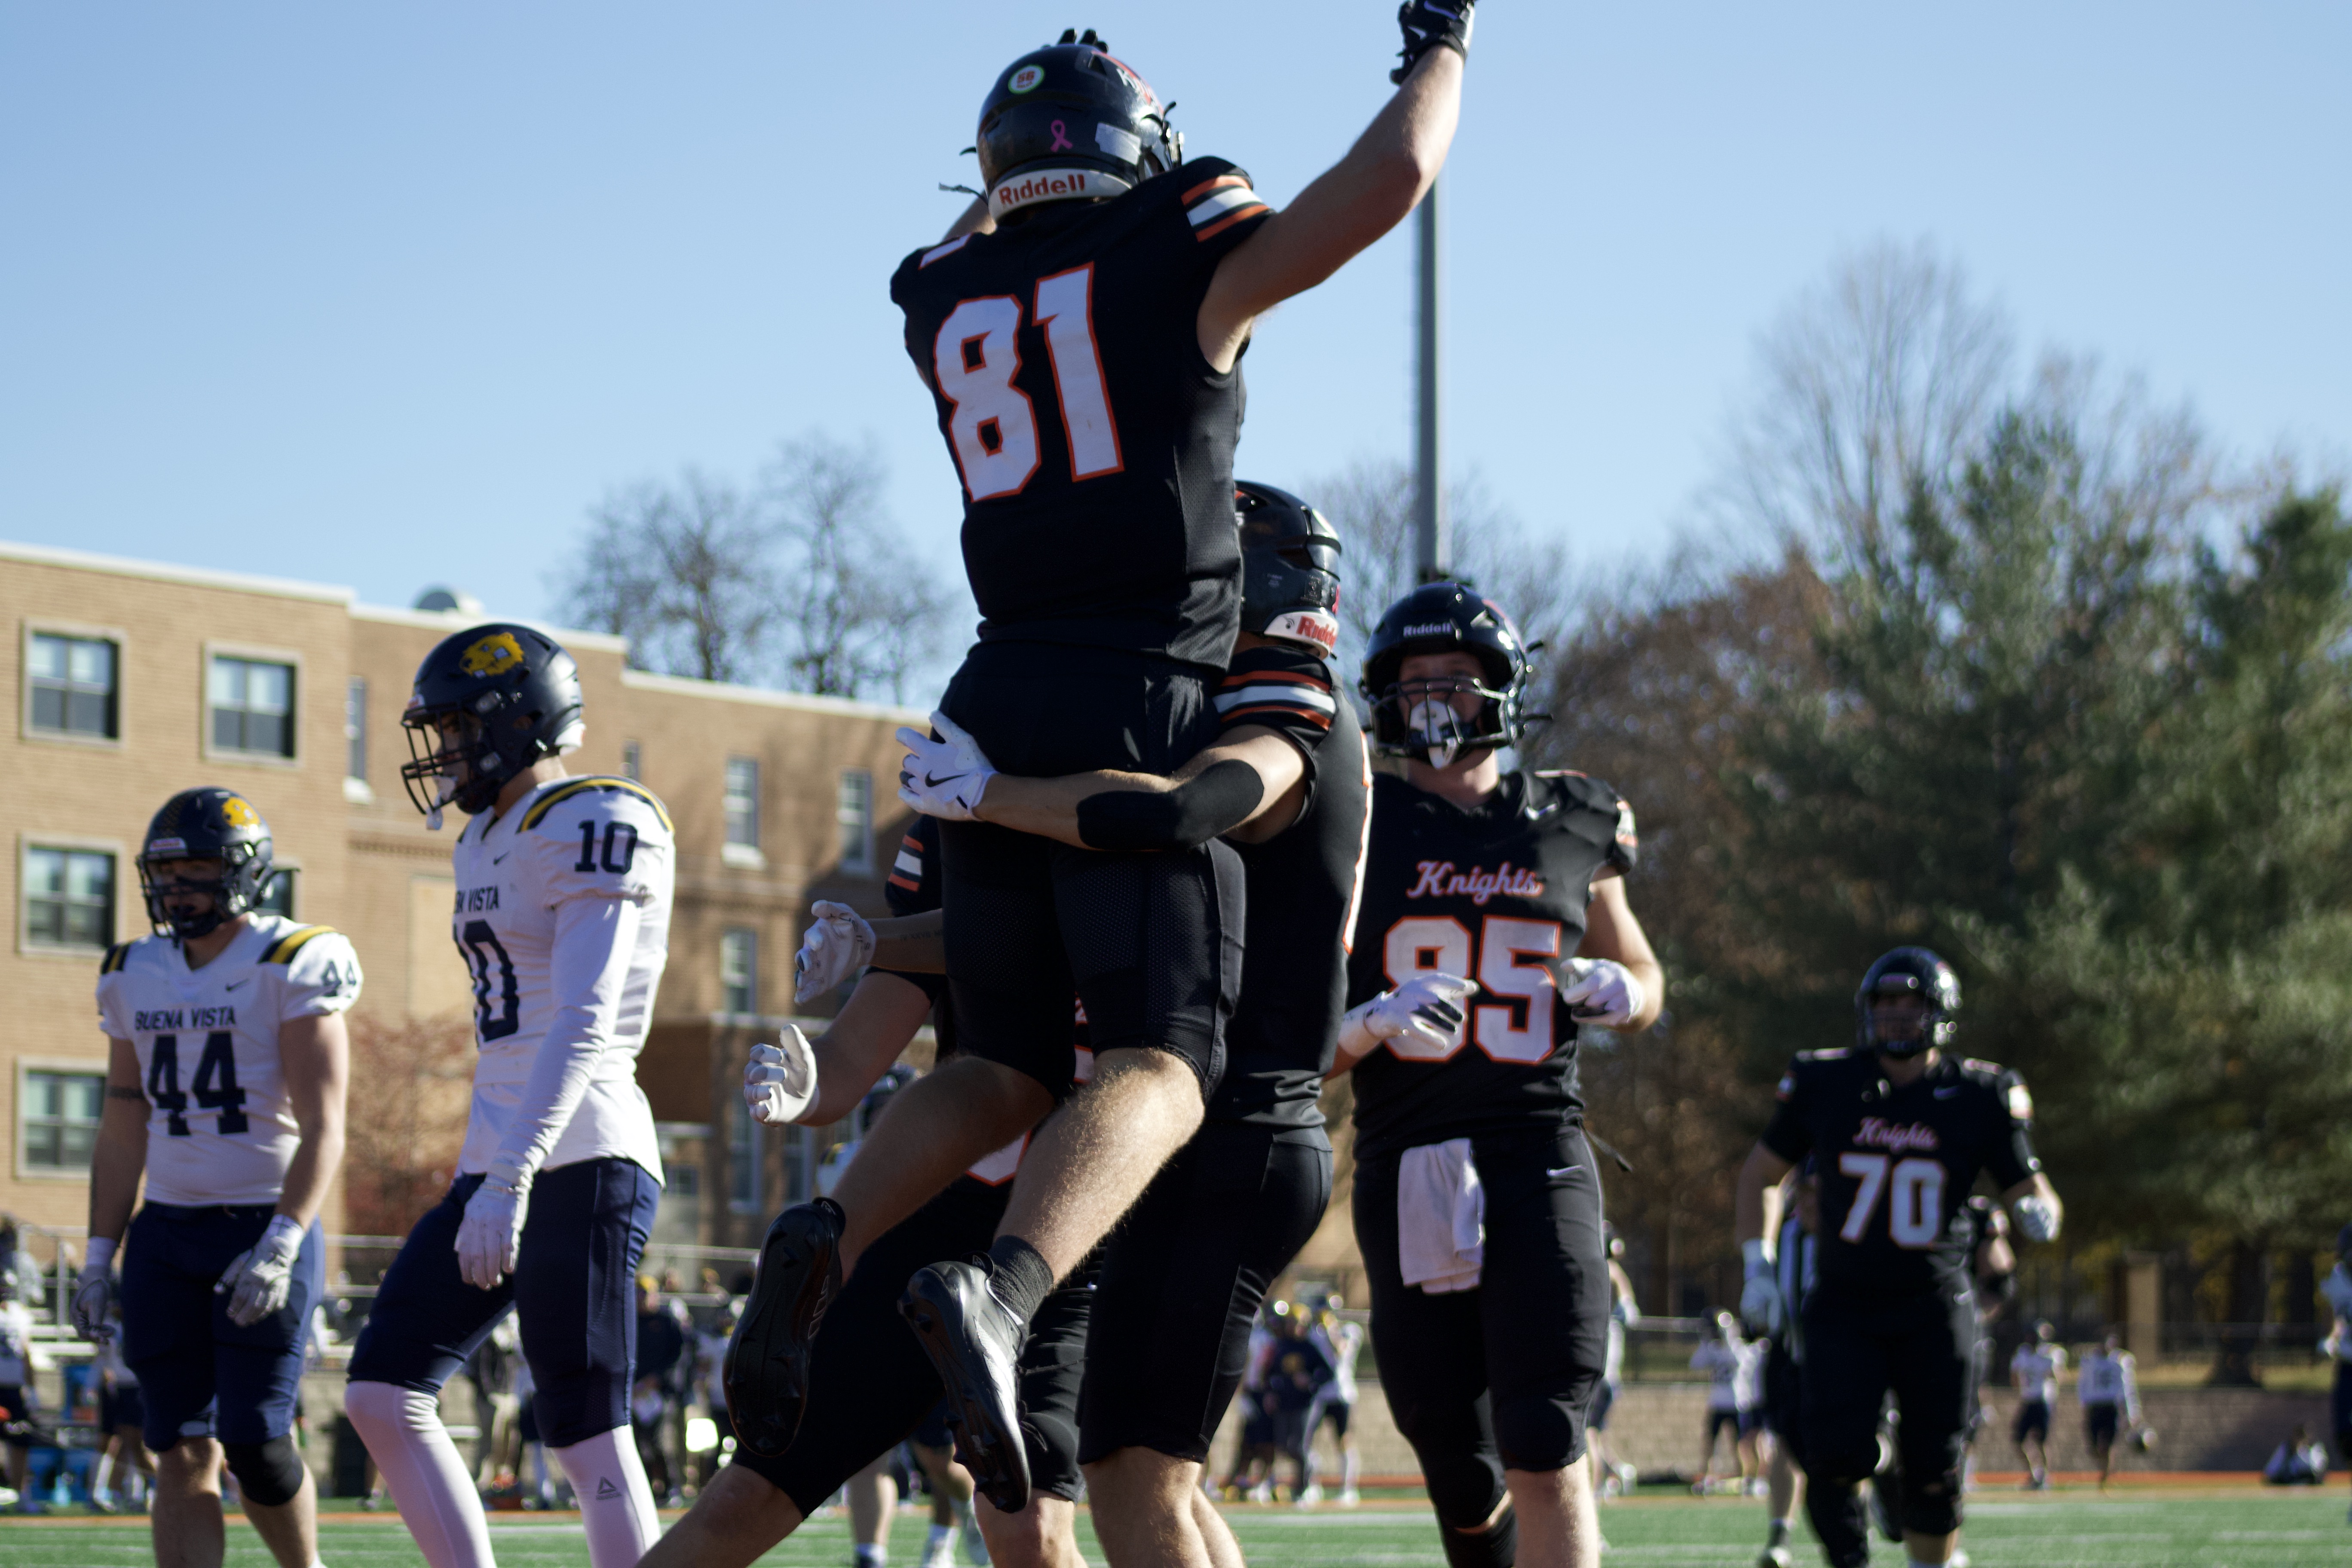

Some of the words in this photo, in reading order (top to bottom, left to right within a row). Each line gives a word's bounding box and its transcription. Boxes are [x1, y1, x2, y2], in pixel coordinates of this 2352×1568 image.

[998, 173, 1085, 205] Riddell
[933, 260, 1124, 502] 81
[1296, 616, 1337, 648] Ridd
[1403, 622, 1452, 638] Riddell
[574, 819, 638, 875] 10
[1406, 860, 1545, 906] Knights
[321, 959, 356, 998] 44
[1382, 913, 1562, 1066] 85
[135, 1010, 184, 1031] BUENA
[190, 1006, 236, 1028] VISTA
[147, 1031, 248, 1136] 44
[1853, 1116, 1939, 1152] Knights
[1838, 1153, 1947, 1248] 70
